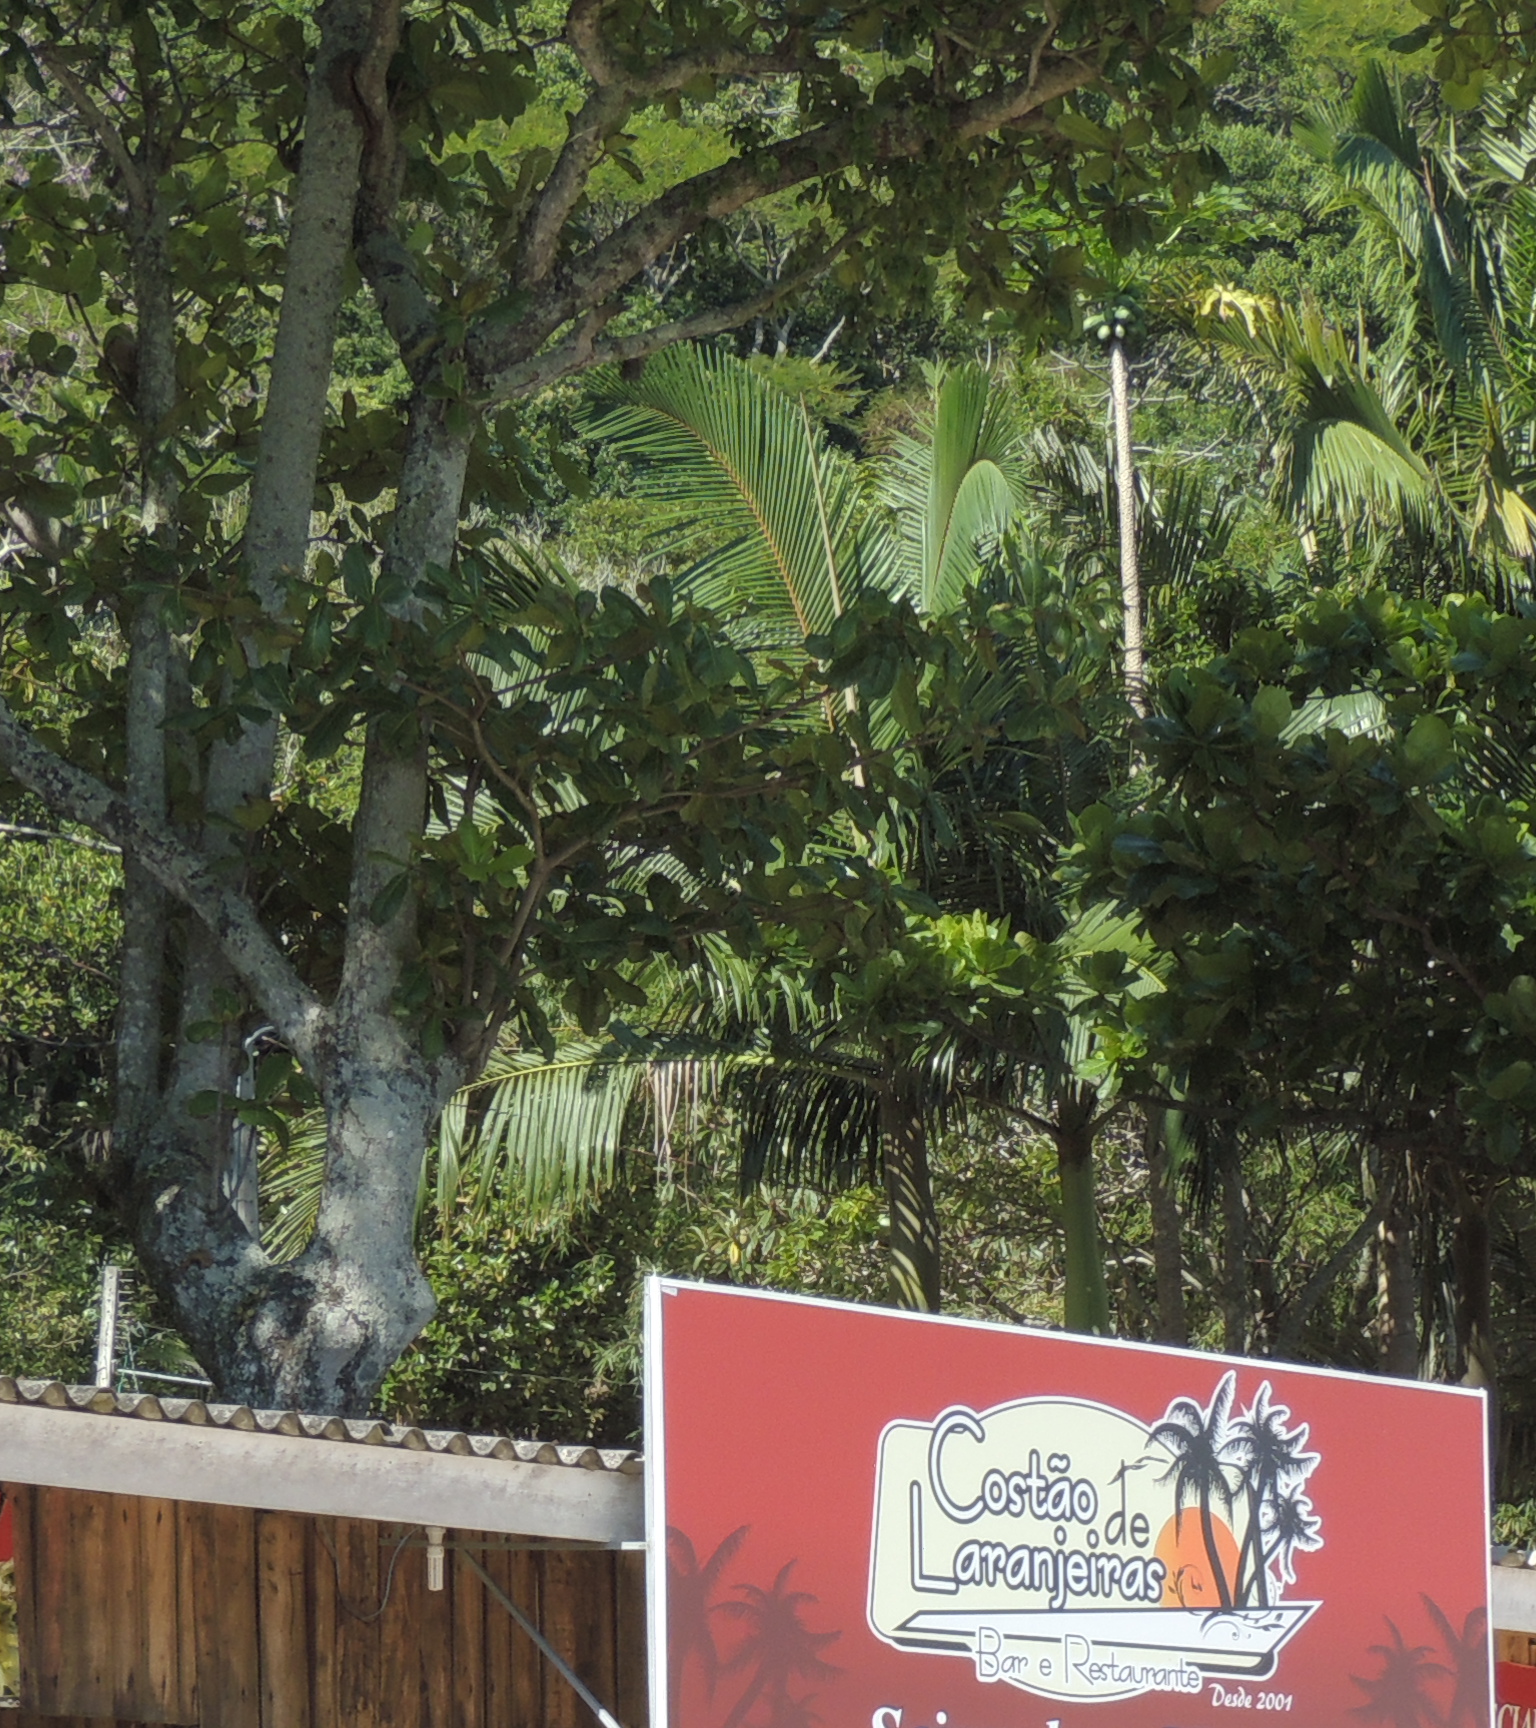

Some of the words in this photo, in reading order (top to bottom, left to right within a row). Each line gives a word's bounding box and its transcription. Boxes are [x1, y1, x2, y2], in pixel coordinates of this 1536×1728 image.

[927, 1405, 1098, 1524] Costão
[1104, 1459, 1150, 1548] de
[910, 1478, 1167, 1609] Laranjeiras
[977, 1627, 1030, 1680] Bar
[1039, 1660, 1052, 1678] e
[1064, 1634, 1202, 1691] Restaurante
[1210, 1680, 1252, 1710] Desde
[1257, 1688, 1293, 1711] 2001
